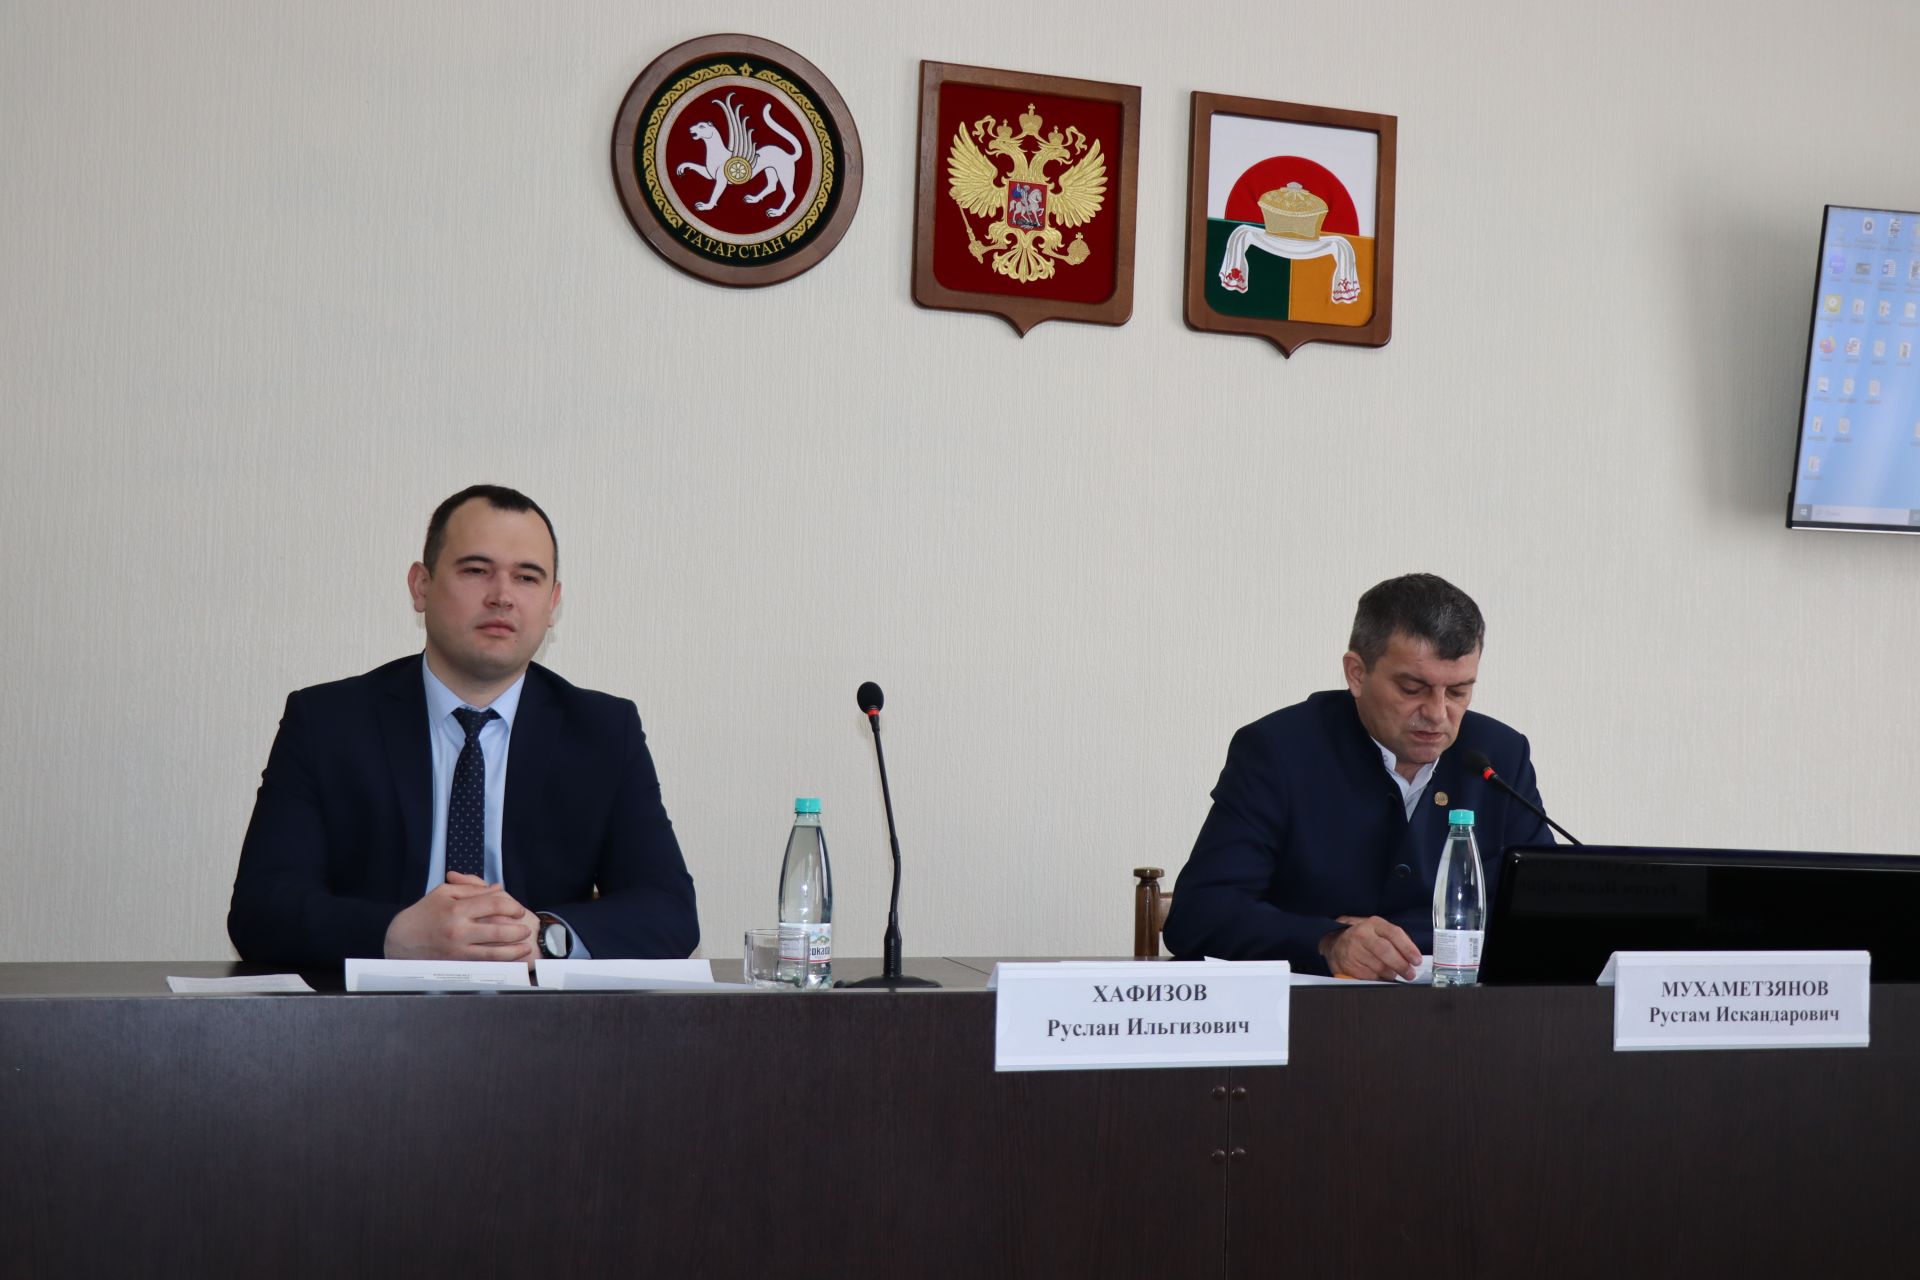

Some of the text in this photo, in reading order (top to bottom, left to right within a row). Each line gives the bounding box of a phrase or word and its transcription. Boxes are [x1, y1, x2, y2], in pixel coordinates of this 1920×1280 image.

[682, 226, 786, 258] ТАТАРСТАН
[1092, 984, 1208, 1003] ХАФИЗОВ
[1661, 980, 1829, 998] МУХАМЕТЗЯНОВ
[1649, 1006, 1839, 1026] Рустам Искандарович
[1047, 1017, 1249, 1041] Руслан Ильгизович
